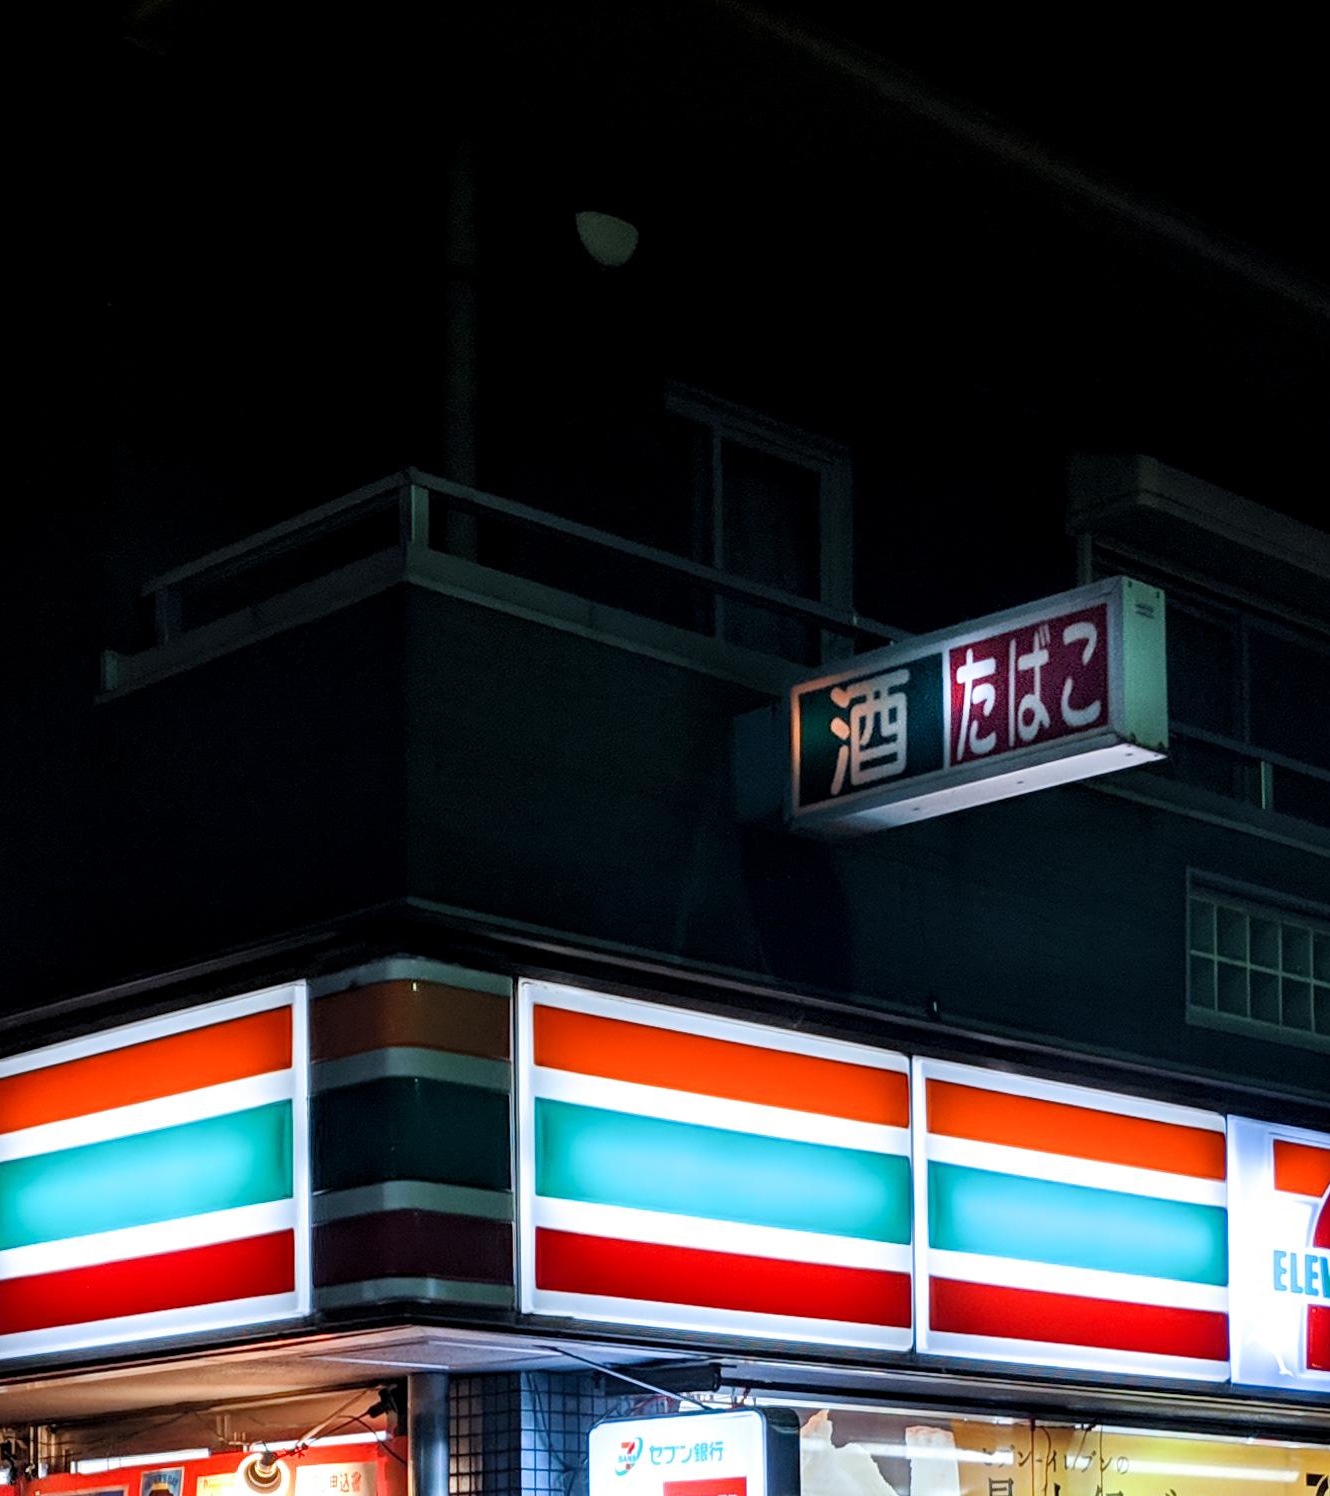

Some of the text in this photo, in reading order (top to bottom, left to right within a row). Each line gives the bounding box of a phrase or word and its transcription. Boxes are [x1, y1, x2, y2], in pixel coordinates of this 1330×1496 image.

[830, 621, 1102, 797] 酒 たばこ
[649, 1441, 725, 1466] セブン銀行
